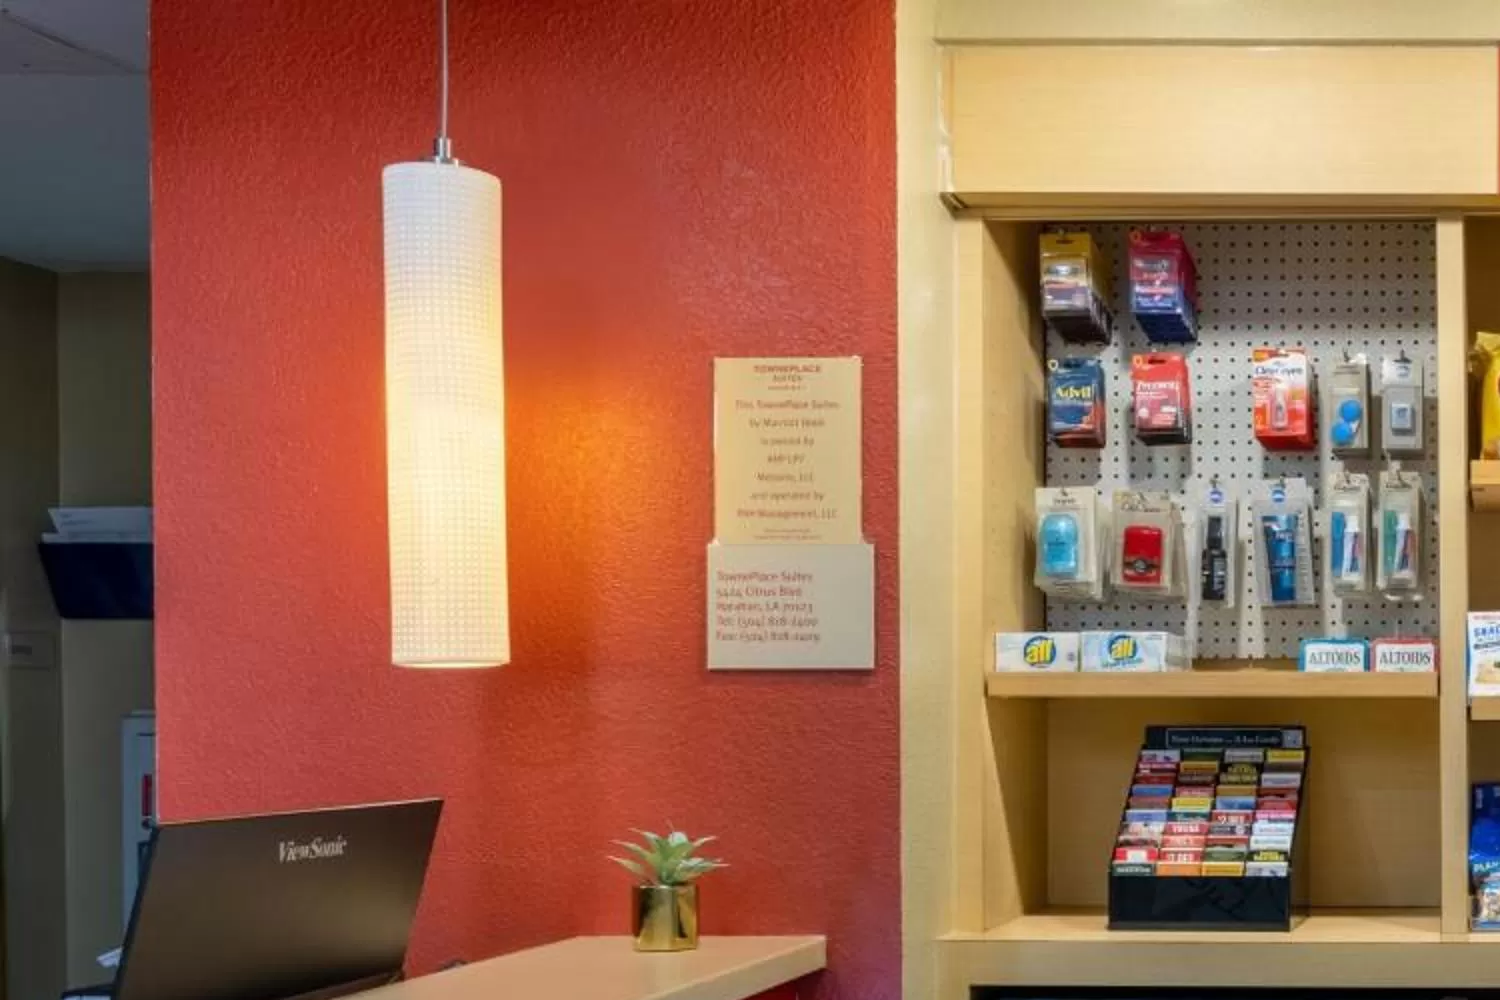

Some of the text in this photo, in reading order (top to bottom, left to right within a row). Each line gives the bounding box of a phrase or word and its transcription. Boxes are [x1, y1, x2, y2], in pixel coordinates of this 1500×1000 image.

[1056, 384, 1093, 400] Advil
[1026, 638, 1054, 664] all
[1111, 637, 1136, 660] all
[1309, 650, 1361, 665] ALTOIDS
[1379, 650, 1431, 665] ALTOIDS
[279, 834, 348, 864] ViewSonic
